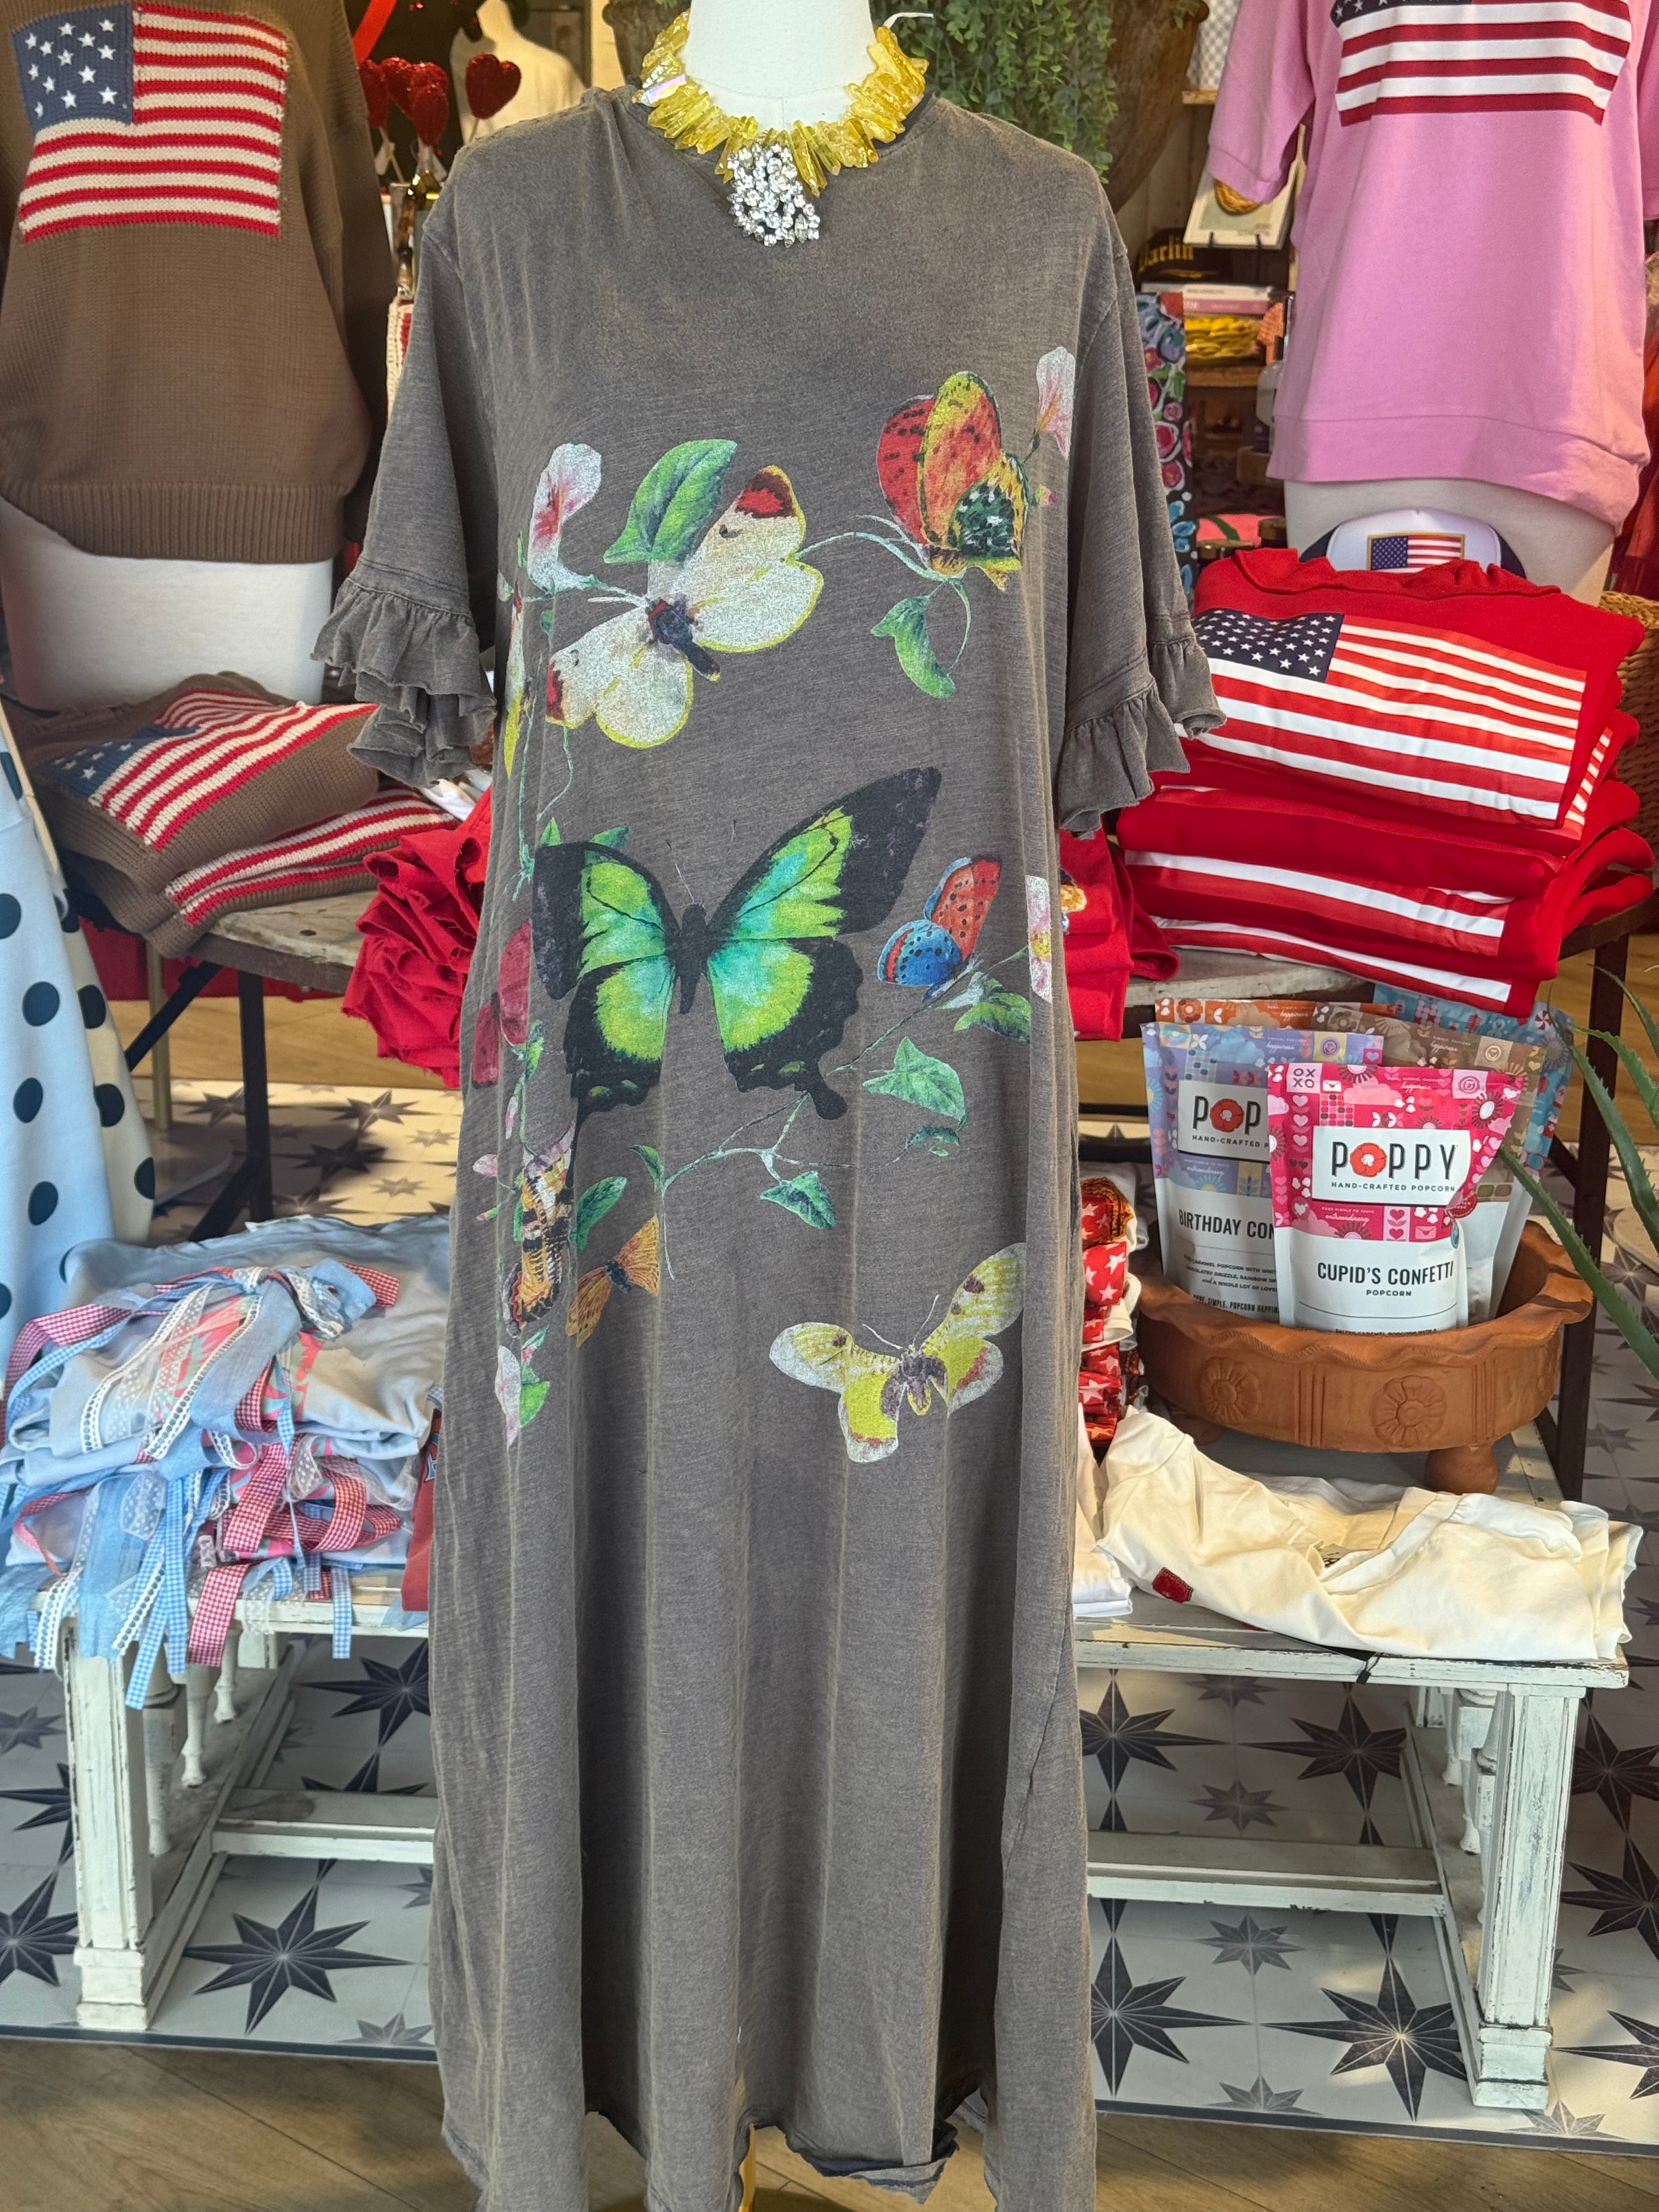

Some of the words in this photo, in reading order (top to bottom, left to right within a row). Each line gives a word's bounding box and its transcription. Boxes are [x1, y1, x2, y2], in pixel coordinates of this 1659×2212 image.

[1192, 1135, 1260, 1148] HAND-CRAFTED
[1331, 1141, 1456, 1181] POPPY
[1331, 1181, 1407, 1191] HAND-CRAFTED
[1178, 1208, 1242, 1236] BIRTHDAY
[1216, 1262, 1244, 1271] POPCORN
[1317, 1262, 1381, 1284] CUPID'S
[1387, 1261, 1454, 1285] CONFETTI
